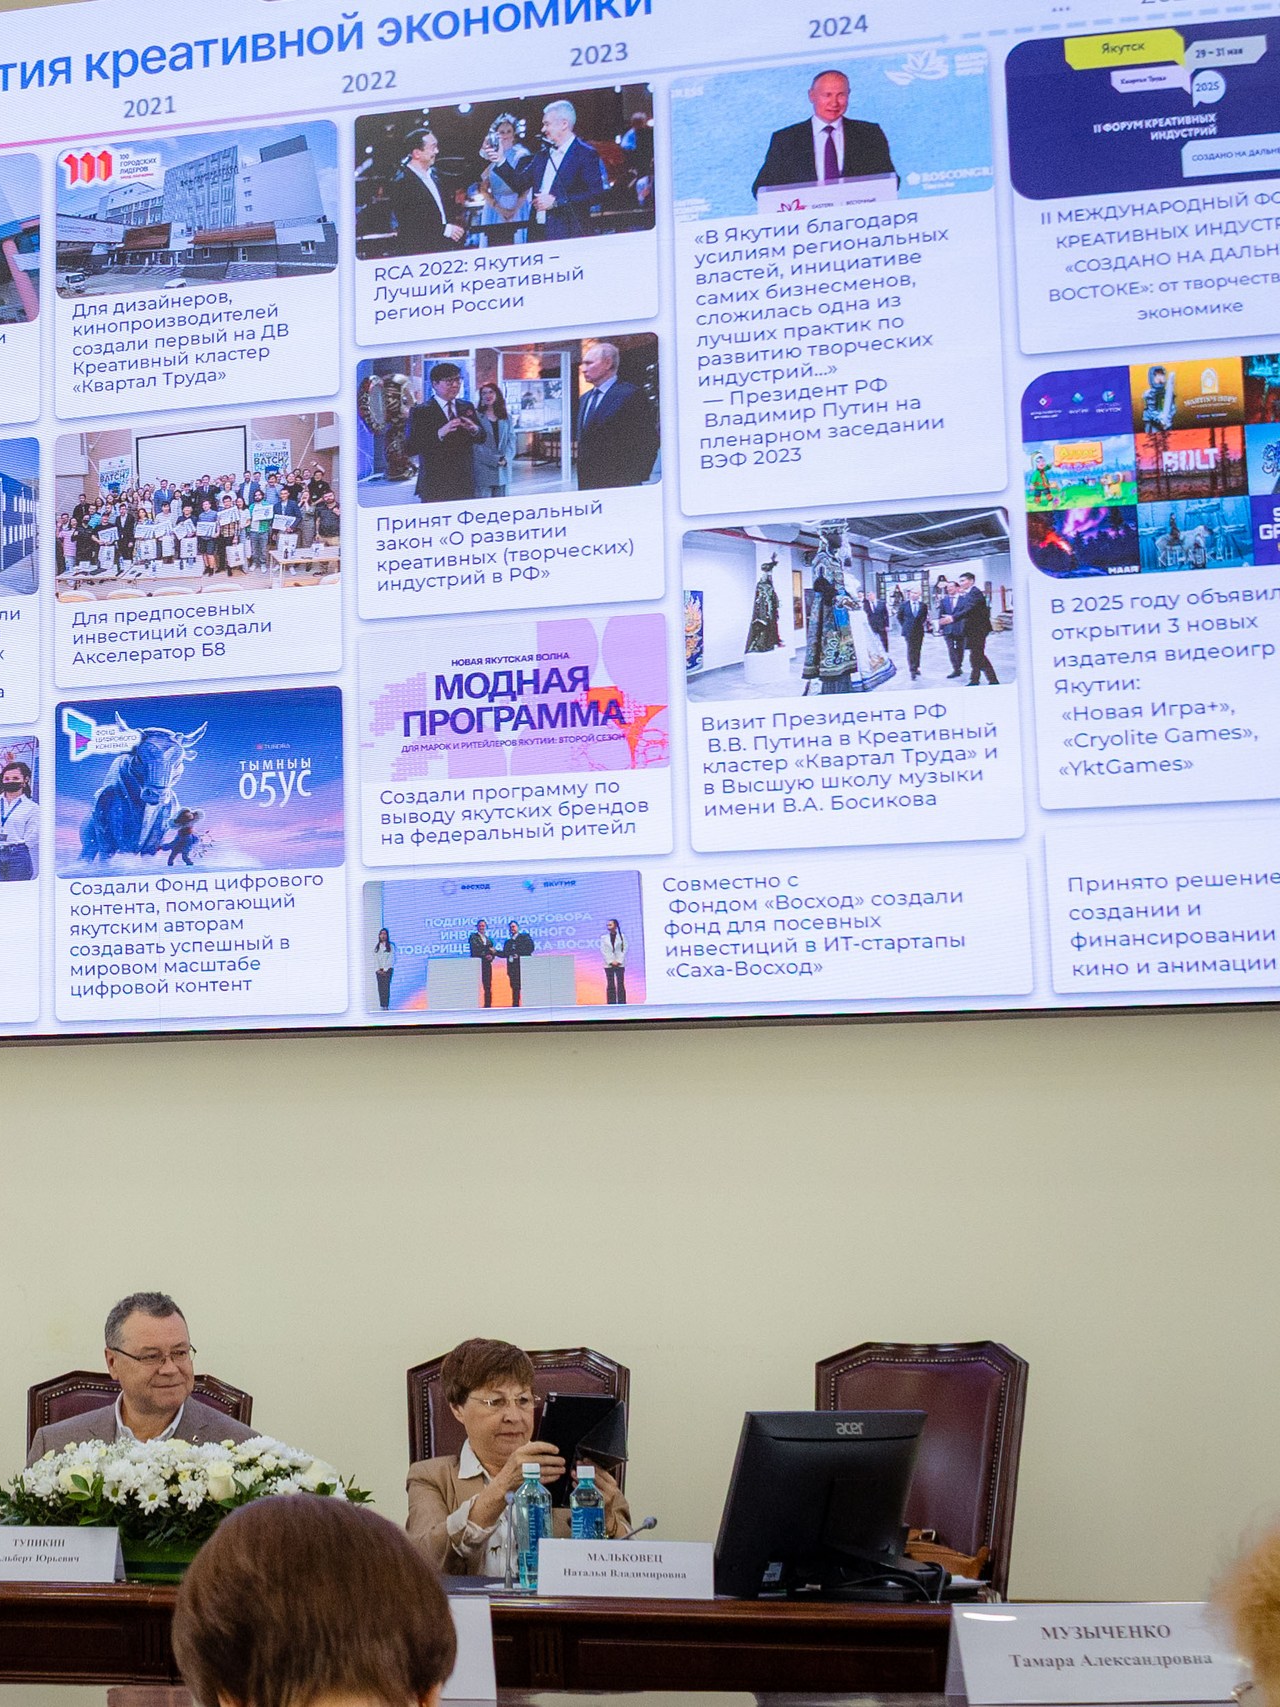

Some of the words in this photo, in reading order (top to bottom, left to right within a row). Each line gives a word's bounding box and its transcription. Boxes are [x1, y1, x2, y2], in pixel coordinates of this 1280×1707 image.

[809, 13, 869, 40] 2024
[85, 12, 363, 89] креативной
[378, 0, 653, 47] экономики
[570, 40, 629, 68] 2023
[1101, 42, 1145, 55] Якутск
[341, 69, 397, 94] 2022
[1195, 81, 1220, 92] 2025
[123, 94, 176, 120] 2021
[1102, 120, 1144, 133] ФОРУМ
[1144, 112, 1217, 129] КРЕАТИВНЫХ
[1151, 124, 1217, 141] ИНДУСТРИЙ
[694, 228, 720, 246] «В
[724, 222, 800, 245] Якутии
[806, 210, 919, 235] благодаря
[373, 278, 455, 305] Лучший
[460, 264, 584, 296] креативный
[71, 301, 109, 321] Для
[112, 291, 233, 317] дизайнеров,
[1137, 300, 1244, 321] экономике
[72, 302, 279, 337] кинопроизводителей
[72, 375, 158, 395] «Квартал
[162, 369, 227, 389] Труда»
[699, 427, 822, 450] пленарном
[828, 417, 945, 440] заседании
[700, 450, 748, 471] ВЭФ
[753, 446, 803, 466] 2023
[376, 513, 453, 535] Принят
[456, 499, 603, 526] Федеральный
[377, 569, 486, 594] индустрий
[492, 570, 503, 585] в
[509, 564, 551, 583] РФ»
[72, 623, 188, 646] инвестиций
[192, 620, 273, 639] создали
[71, 645, 196, 666] Акселератор
[201, 640, 227, 659] Б8
[451, 657, 483, 667] НОВАЯ
[484, 654, 534, 665] ЯКУТСКАЯ
[535, 652, 569, 662] ВОЛНА
[435, 665, 589, 703] МОДНАЯ
[1054, 677, 1141, 698] Якутии:
[403, 699, 626, 738] ПРОГРАММА
[701, 715, 766, 733] Визит
[772, 707, 907, 731] Президента
[913, 702, 948, 720] РФ
[401, 744, 420, 753] ДЛЯ
[420, 742, 451, 751] МАРОК
[461, 738, 518, 750] РИТЕЙЛЕРОВ
[1063, 728, 1159, 753] «Cryolite
[1164, 726, 1259, 745] Games»,
[239, 757, 311, 771] ТЫМНЫЫ
[1059, 757, 1194, 778] «YktGames»
[379, 788, 466, 806] Создали
[472, 782, 589, 804] программу
[594, 780, 621, 795] по
[704, 801, 776, 817] имени
[782, 795, 824, 814] В.А.
[830, 792, 938, 812] Босикова
[662, 875, 782, 894] Совместно
[786, 874, 799, 889] с
[1067, 875, 1169, 897] Принято
[1070, 928, 1277, 952] финансировании
[666, 959, 824, 980] «Саха-Восход»
[70, 978, 169, 1000] цифровой
[174, 978, 253, 994] контент
[835, 1422, 864, 1435] acer
[587, 1552, 663, 1564] МАЛЬКОВЕЦ
[563, 1568, 607, 1578] Наталья
[610, 1569, 687, 1580] Владимировна
[1041, 1624, 1171, 1641] МУЗЫЧЕНКО
[1008, 1653, 1074, 1670] Тамара
[1080, 1653, 1213, 1669] Александровна
